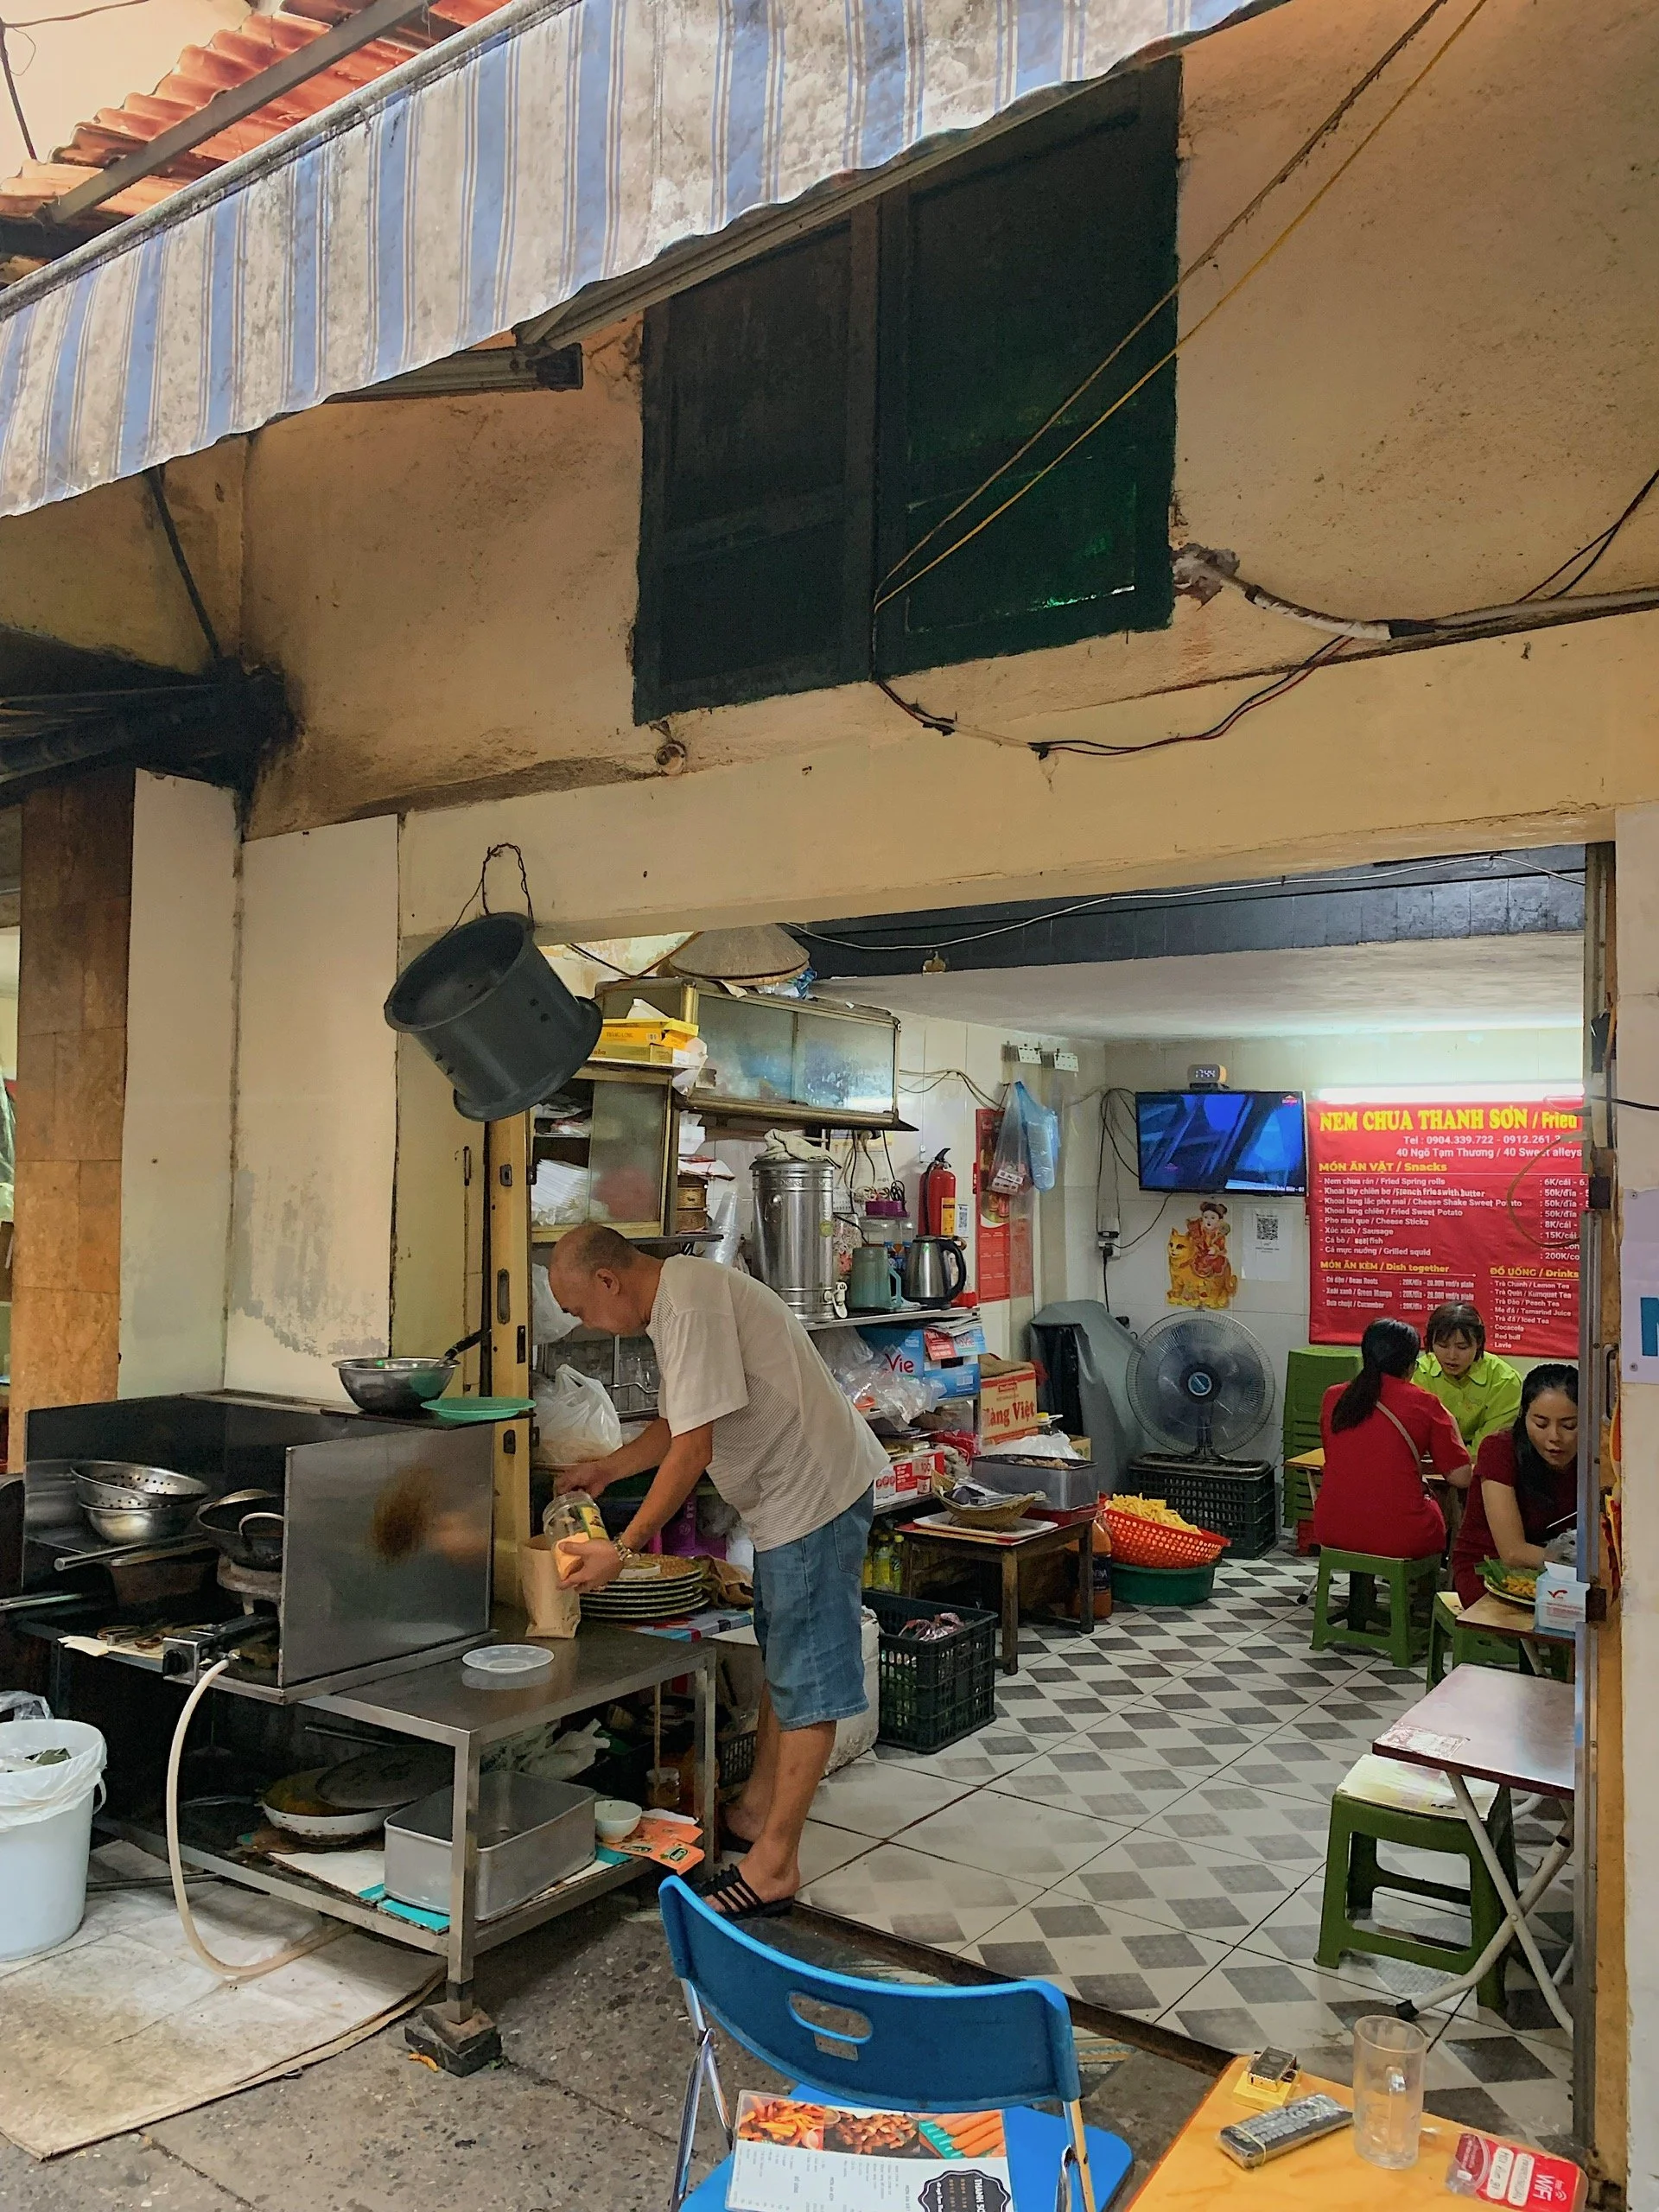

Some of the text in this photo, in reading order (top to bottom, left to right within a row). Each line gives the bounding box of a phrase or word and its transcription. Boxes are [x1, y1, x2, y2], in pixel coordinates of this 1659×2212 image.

[1319, 1111, 1358, 1132] NEM
[1362, 1109, 1414, 1131] CHUA
[1418, 1109, 1484, 1130] THANH
[1489, 1105, 1528, 1129] SƠN
[1403, 1135, 1419, 1145] Tel
[1426, 1135, 1494, 1145] 0904.339.722
[1396, 1148, 1408, 1158] 40
[1433, 1147, 1453, 1159] Tạm
[1503, 1147, 1516, 1157] 40
[1553, 1147, 1582, 1159] alleys
[1319, 1160, 1347, 1172] MÓN
[1404, 1162, 1448, 1172] Snacks
[1402, 1178, 1427, 1186] Spring
[1412, 1208, 1435, 1217] Sweet
[1356, 1217, 1370, 1226] que
[1363, 1228, 1394, 1236] Sausage
[1410, 1249, 1431, 1257] squid
[1386, 1262, 1406, 1271] Dish
[1408, 1264, 1449, 1273] together
[1545, 1269, 1580, 1278] Drinks
[1528, 1291, 1557, 1300] Kumquat
[885, 1353, 914, 1373] Vie
[974, 2178, 985, 2203] THANH
